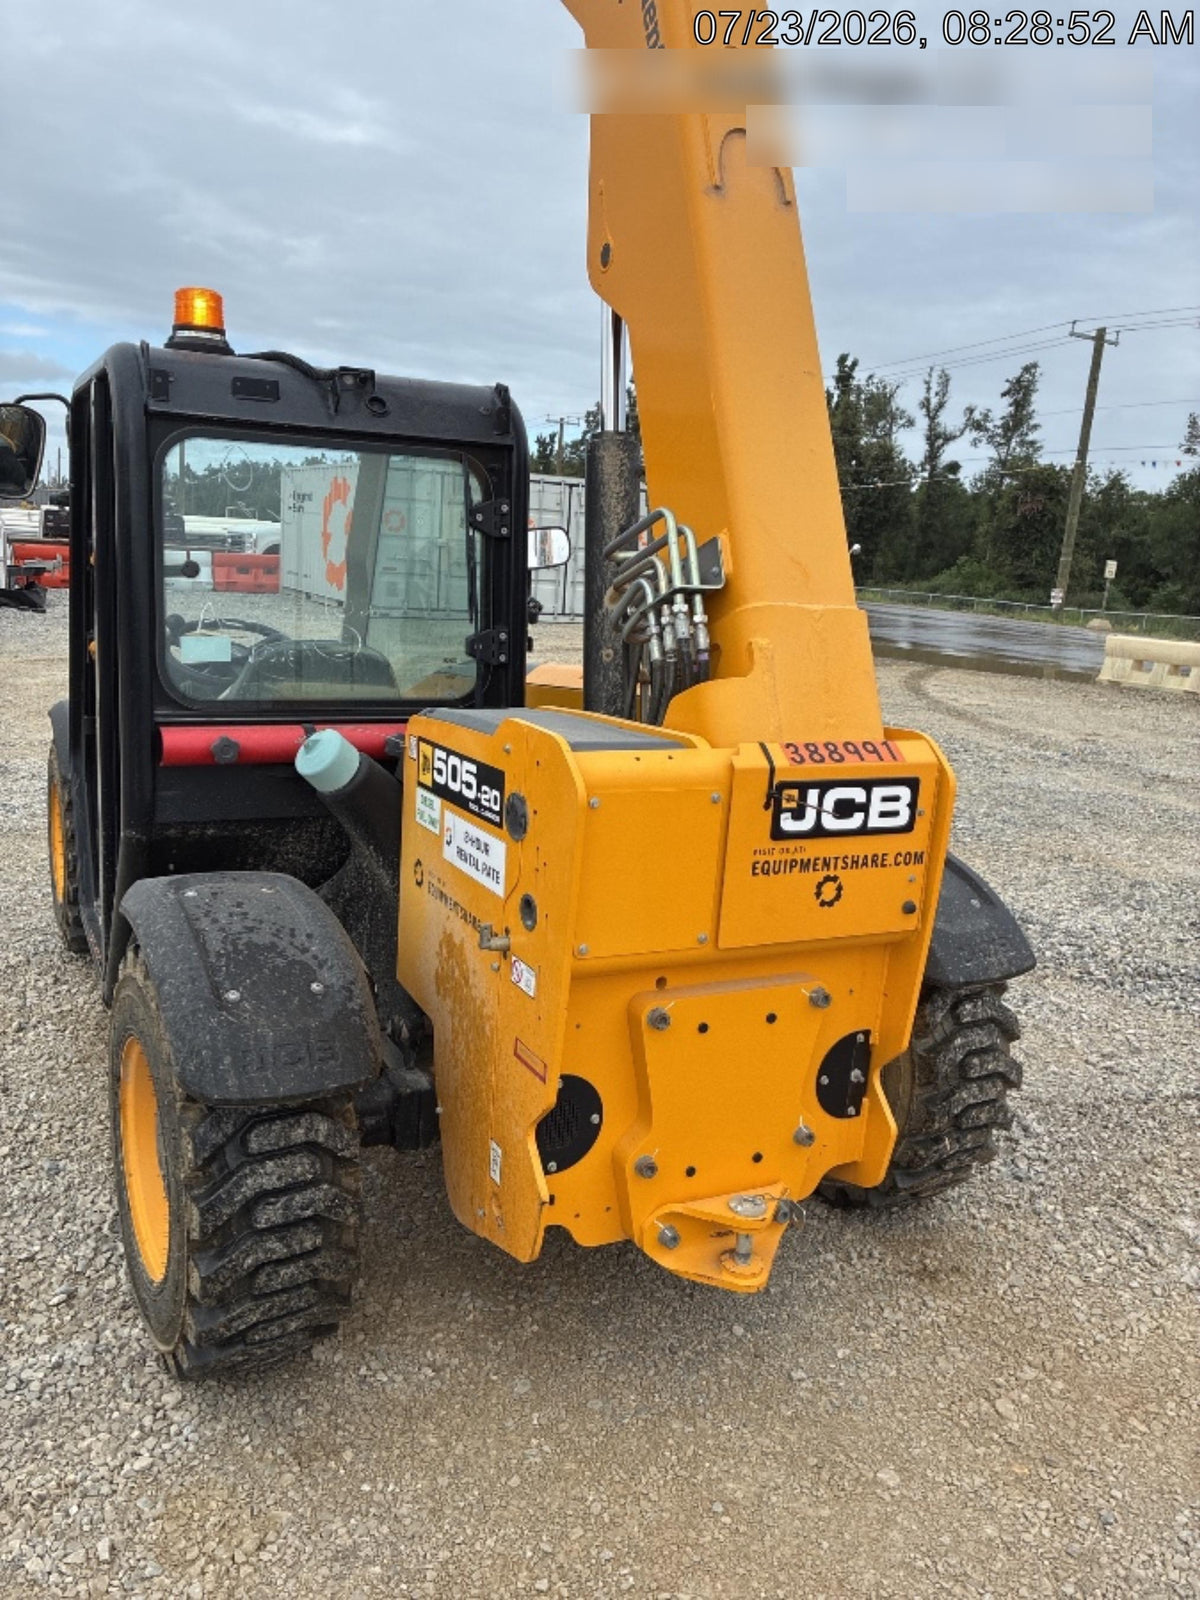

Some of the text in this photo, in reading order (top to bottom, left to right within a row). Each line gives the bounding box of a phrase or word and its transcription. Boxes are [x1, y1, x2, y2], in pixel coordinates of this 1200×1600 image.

[784, 740, 899, 764] 388991
[780, 785, 911, 831] JCB
[751, 851, 925, 877] EQUIPMENTSHARE.COM
